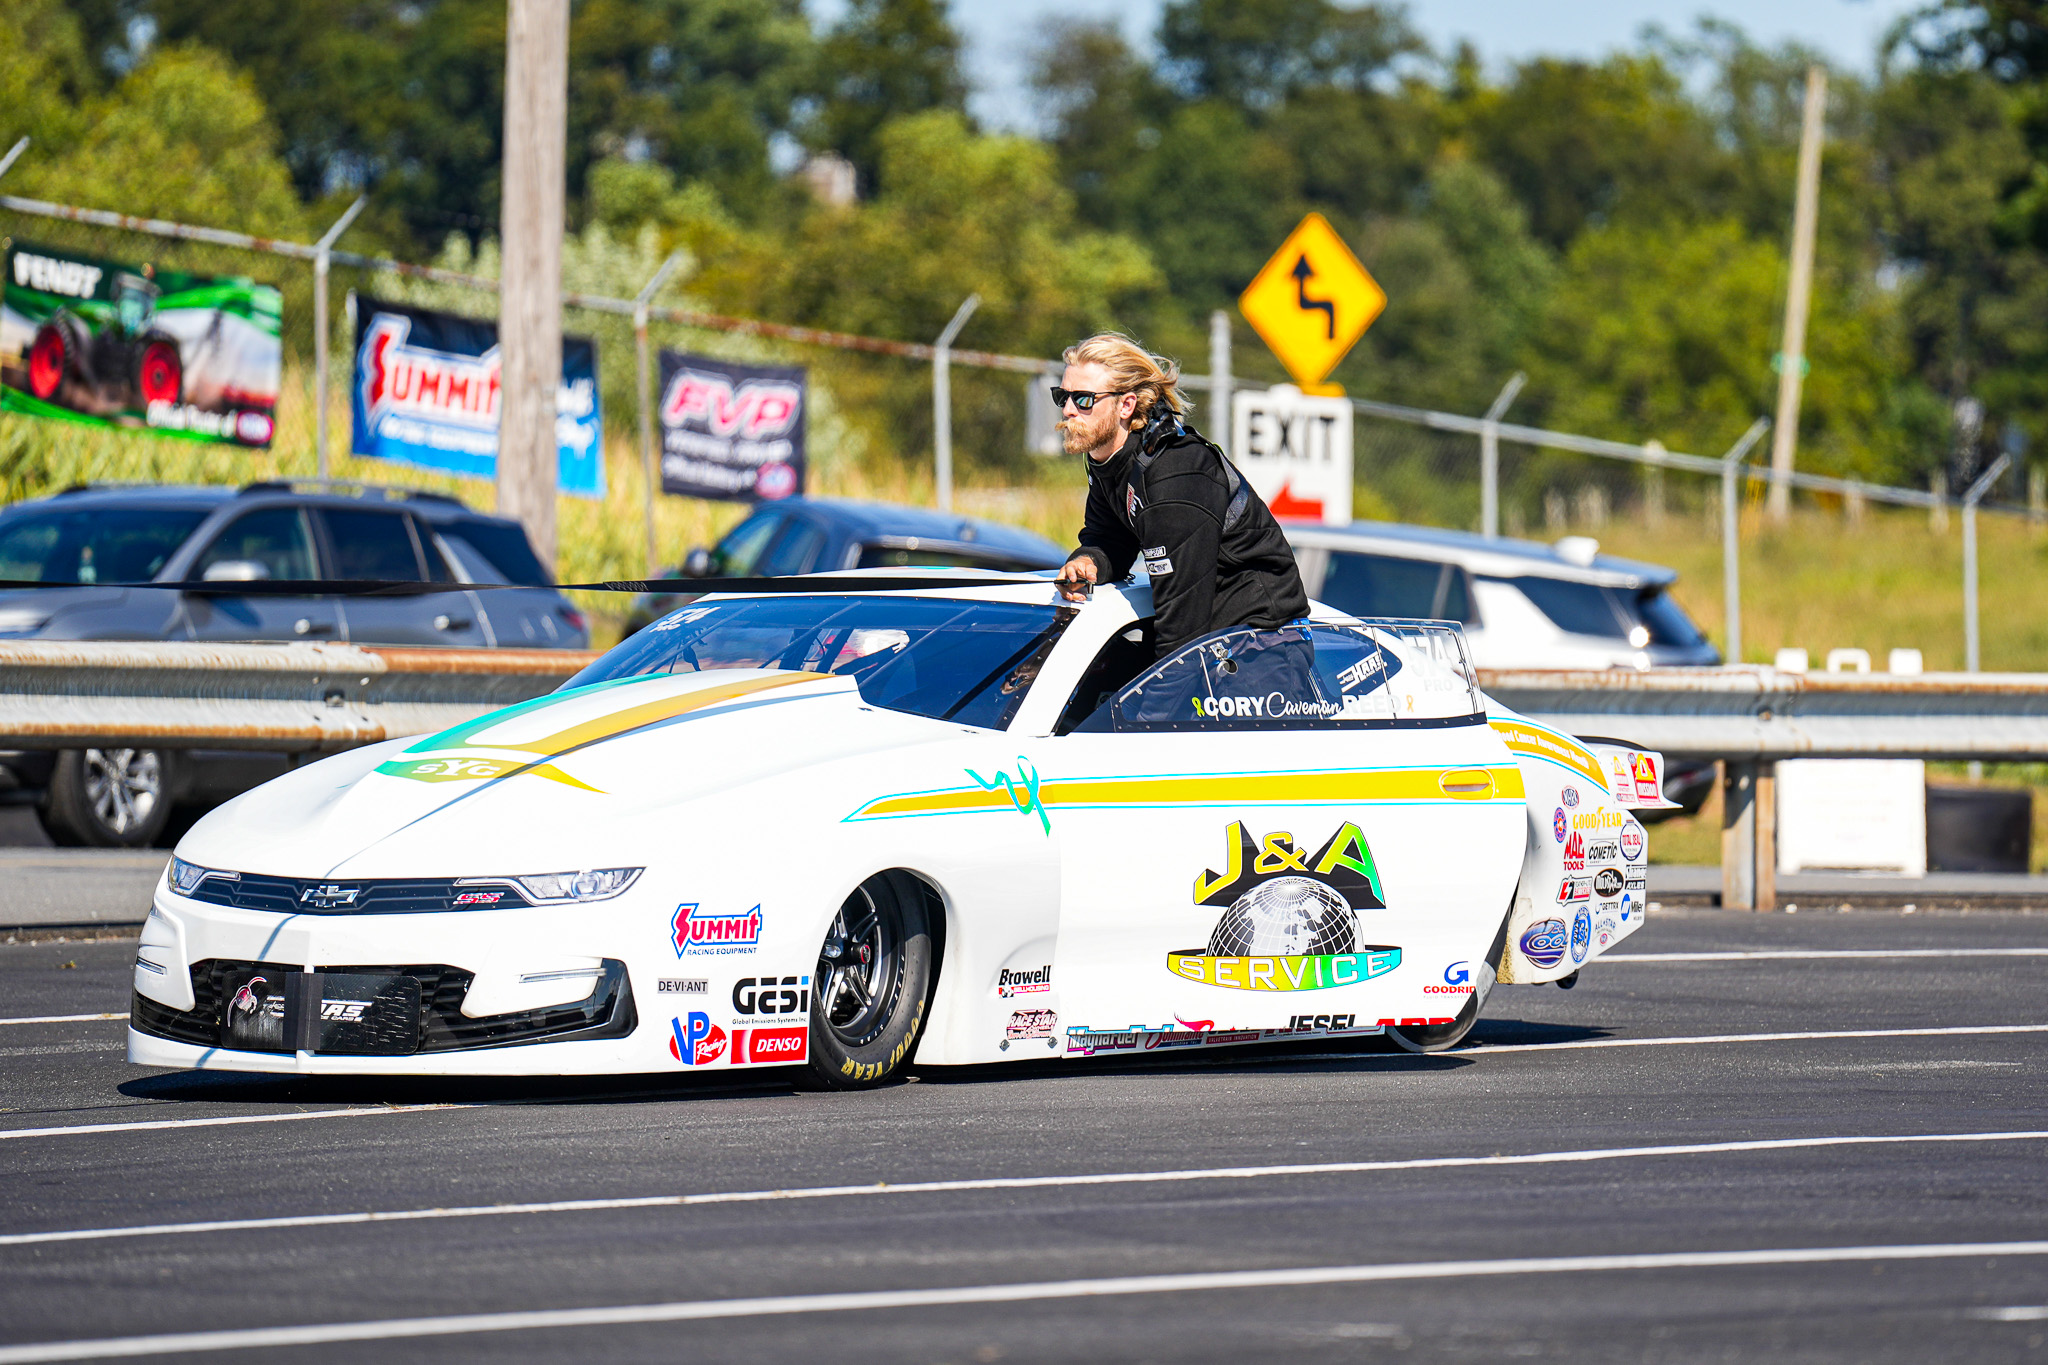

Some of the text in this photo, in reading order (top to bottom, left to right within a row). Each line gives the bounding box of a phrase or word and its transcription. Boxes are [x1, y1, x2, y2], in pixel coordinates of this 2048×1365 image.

[14, 252, 103, 299] FENDT
[1249, 410, 1337, 458] EXIT
[1203, 691, 1401, 719] CORY Caveman REED
[1563, 831, 1585, 859] MAC
[1588, 842, 1618, 860] COMETIC
[1563, 861, 1585, 871] TOOLS
[687, 947, 757, 956] RACING EQUIPMENT
[999, 965, 1051, 986] Browell
[1177, 952, 1392, 990] SERVICE
[1009, 1013, 1058, 1028] RACE STAR
[671, 1011, 710, 1065] VP
[696, 1037, 727, 1058] Racing
[756, 1037, 802, 1053] DENSO
